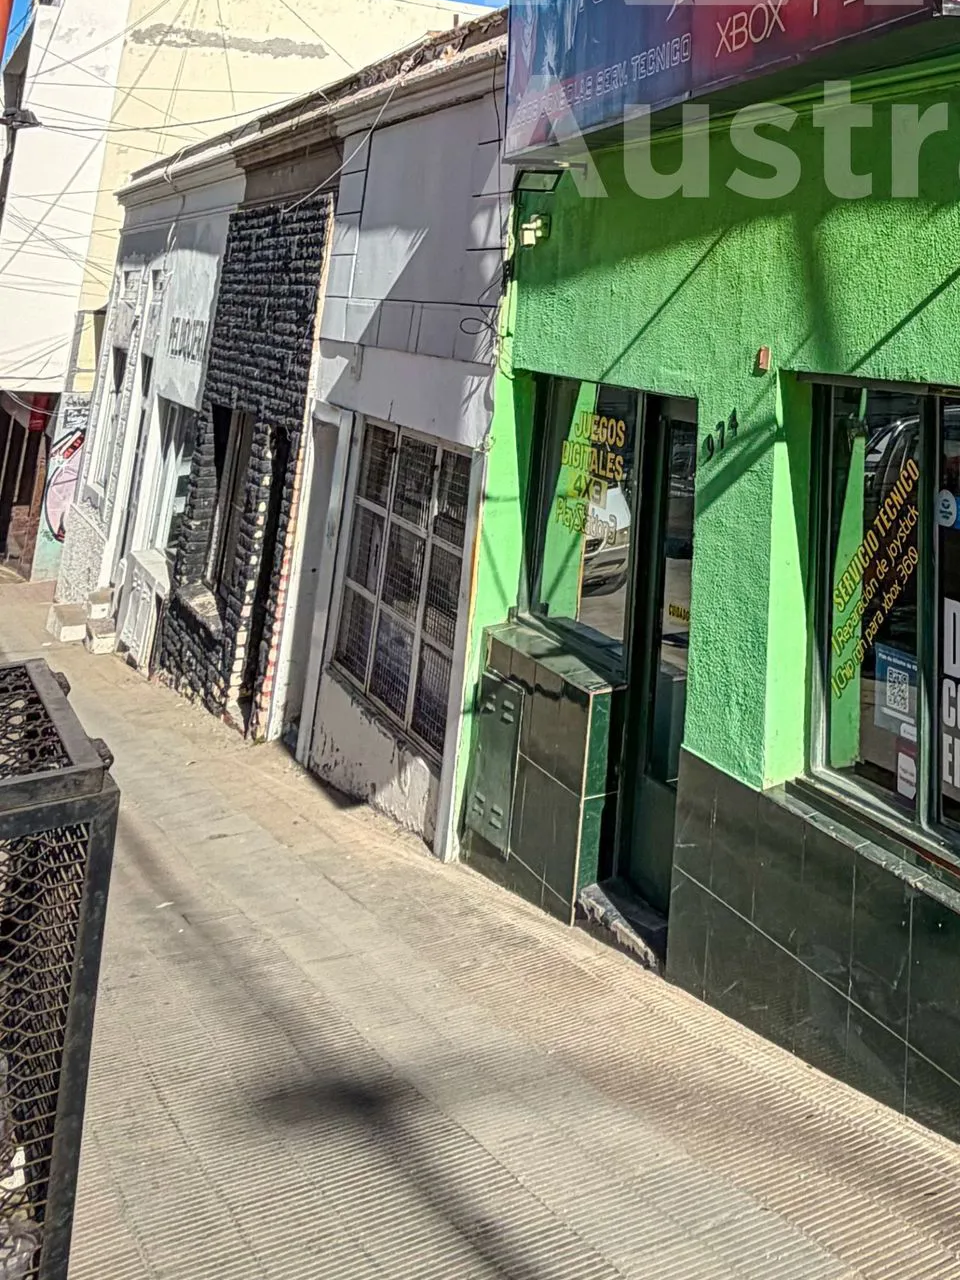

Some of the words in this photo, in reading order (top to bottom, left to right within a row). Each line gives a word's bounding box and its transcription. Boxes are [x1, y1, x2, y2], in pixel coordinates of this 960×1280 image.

[631, 32, 692, 83] TECNICO
[574, 411, 626, 448] JUEGOS
[561, 440, 624, 483] DIGITALES
[834, 529, 880, 612] SERVICIO
[876, 559, 890, 580] de
[837, 658, 856, 691] Chip
[864, 610, 885, 646] para
[881, 579, 902, 614] xbox
[897, 546, 919, 584] 360
